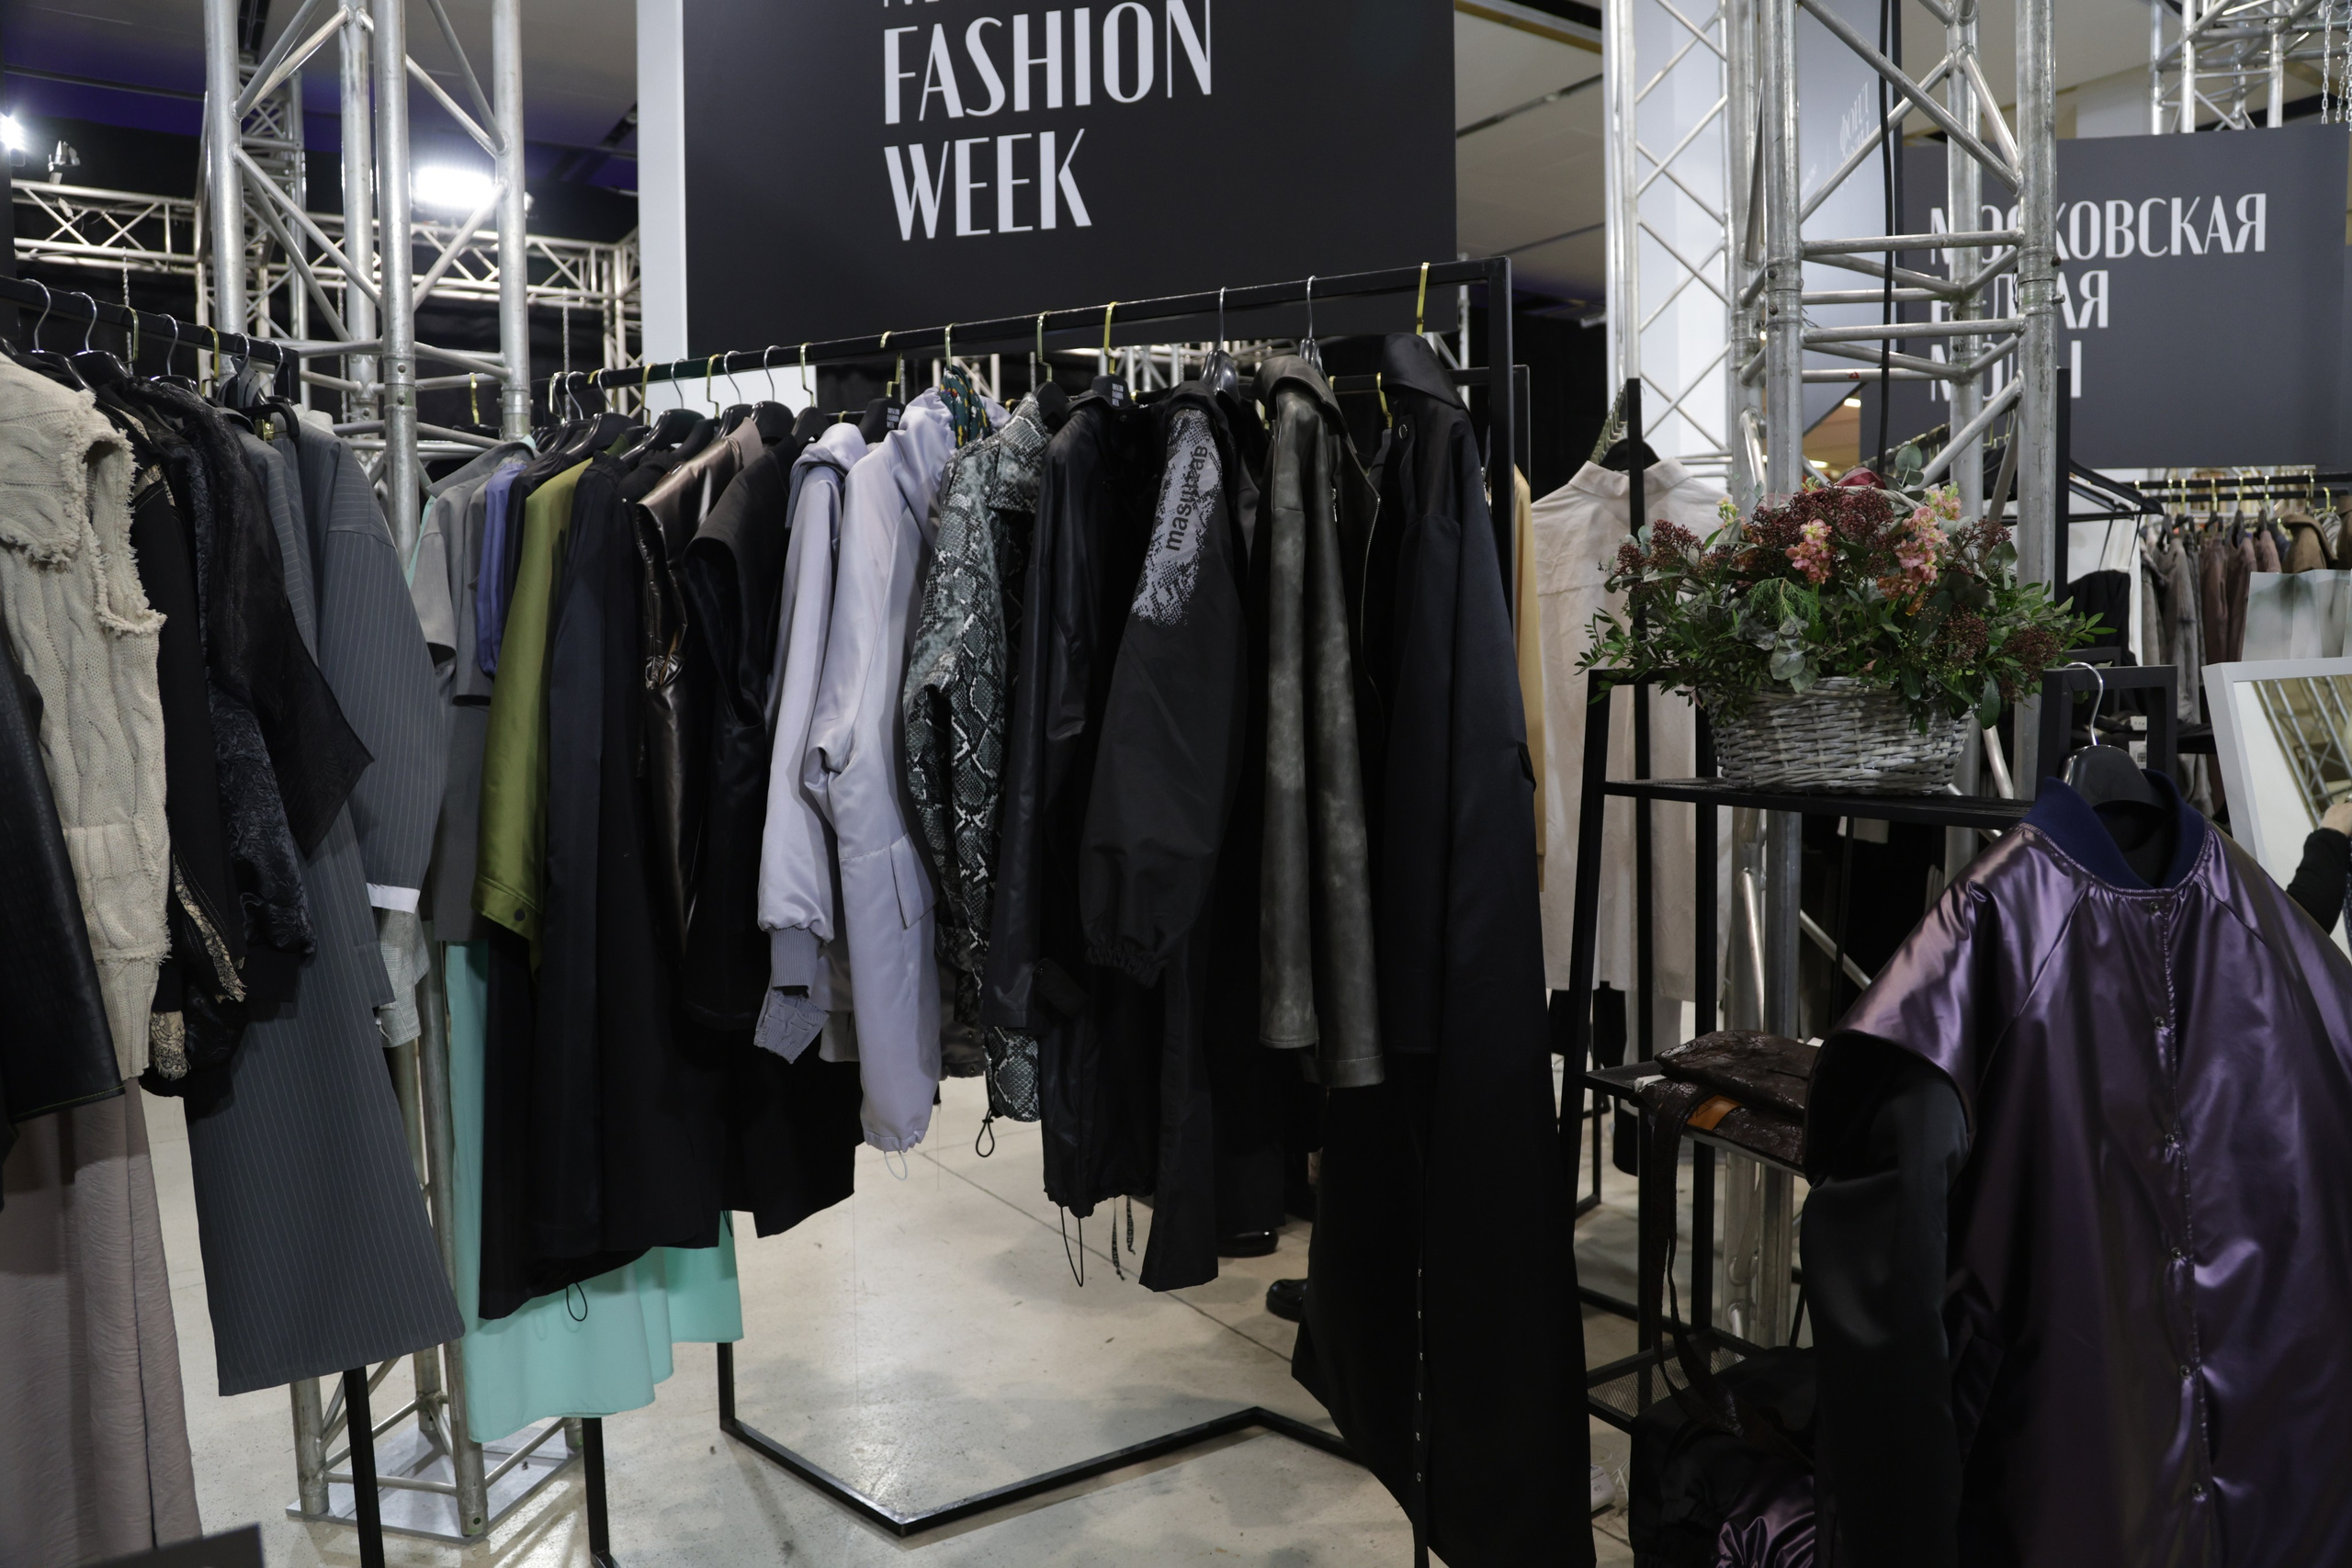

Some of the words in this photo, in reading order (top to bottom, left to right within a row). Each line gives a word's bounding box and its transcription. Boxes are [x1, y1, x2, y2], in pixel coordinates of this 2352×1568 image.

[884, 0, 1212, 125] FASHION
[884, 128, 1092, 242] WEEK
[1930, 193, 2267, 265] ООВСКАЯ
